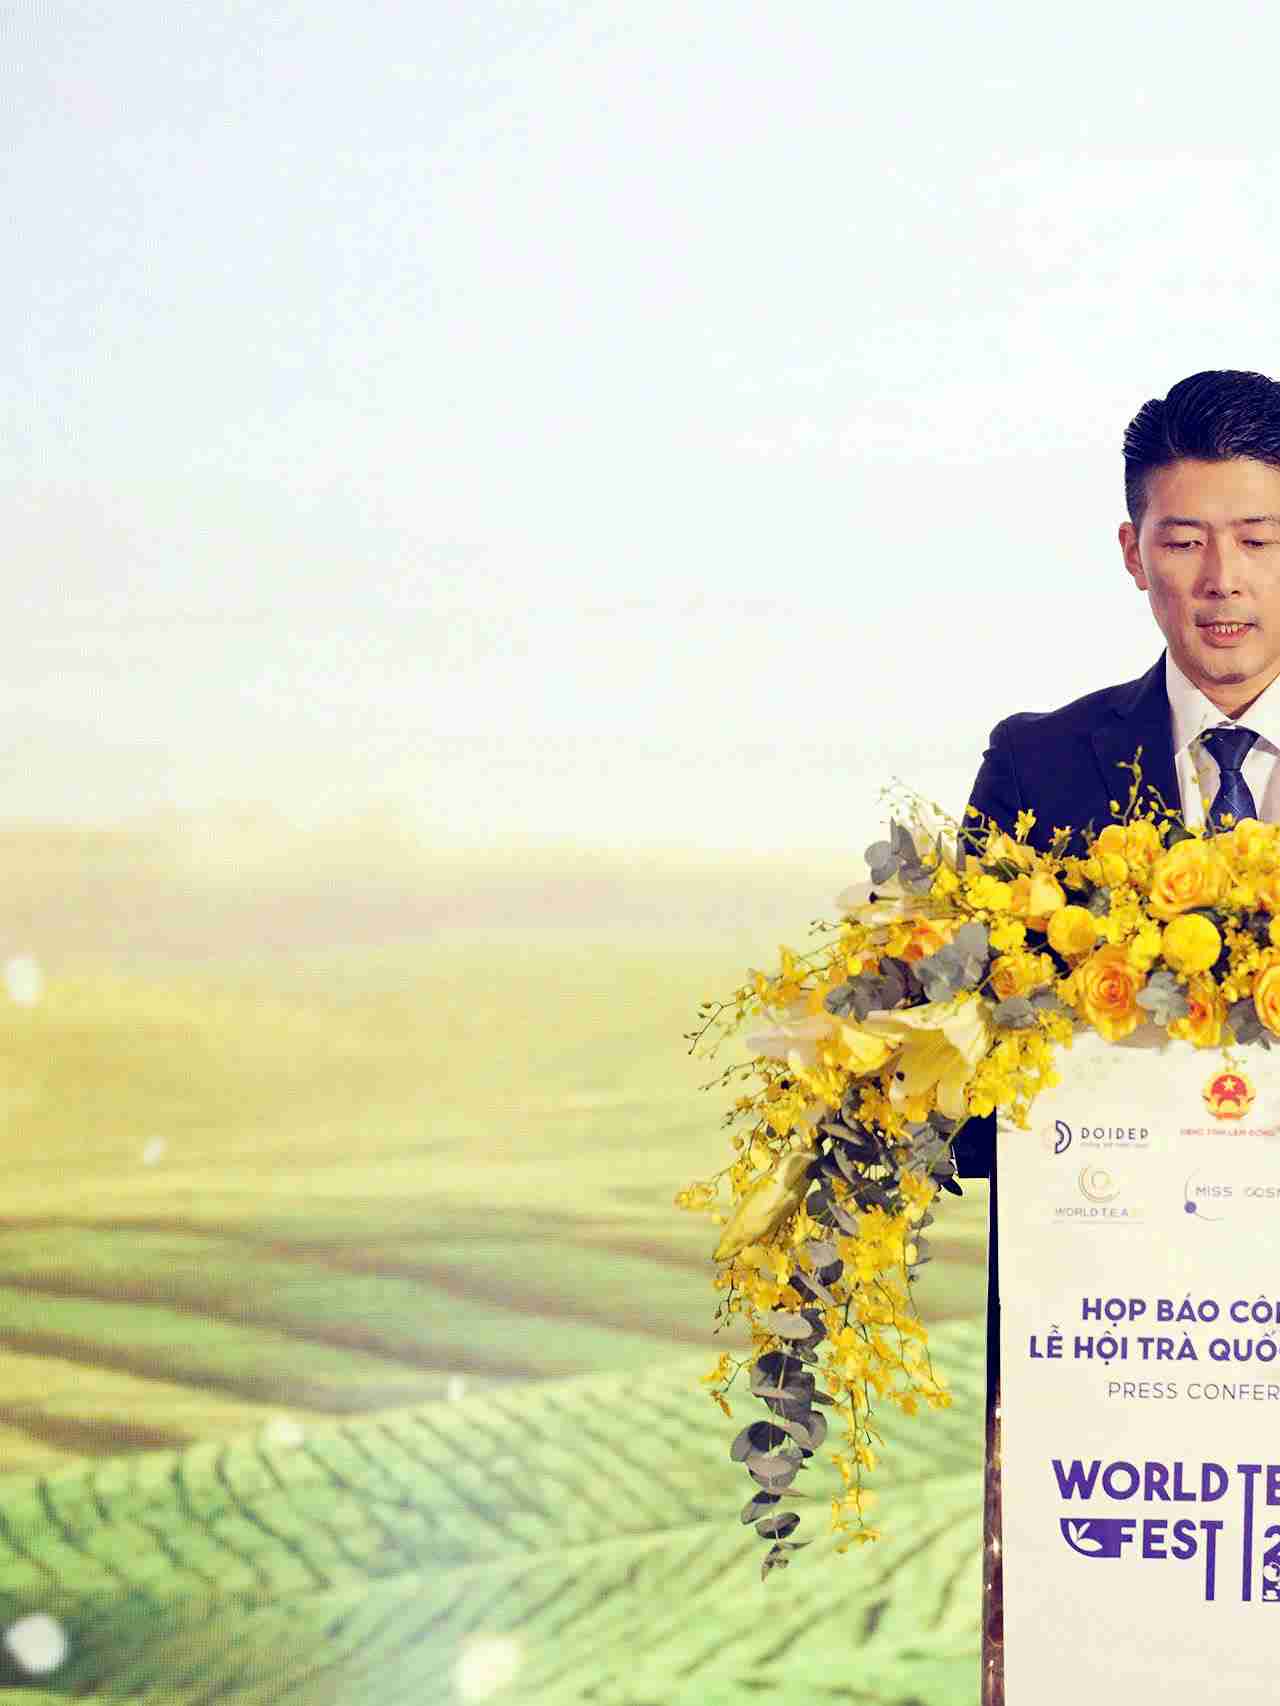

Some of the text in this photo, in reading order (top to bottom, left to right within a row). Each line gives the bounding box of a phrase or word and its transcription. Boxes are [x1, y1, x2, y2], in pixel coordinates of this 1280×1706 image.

[1081, 1127, 1149, 1140] DOIDEP
[1195, 1185, 1233, 1197] MISS
[1082, 1297, 1147, 1327] HỌP
[1157, 1292, 1220, 1323] BÁO
[1029, 1324, 1063, 1359] LỄ
[1074, 1330, 1128, 1366] HỘI
[1137, 1331, 1198, 1361] TRÀ
[1108, 1382, 1178, 1399] PRESS
[1052, 1459, 1229, 1503] WORLD
